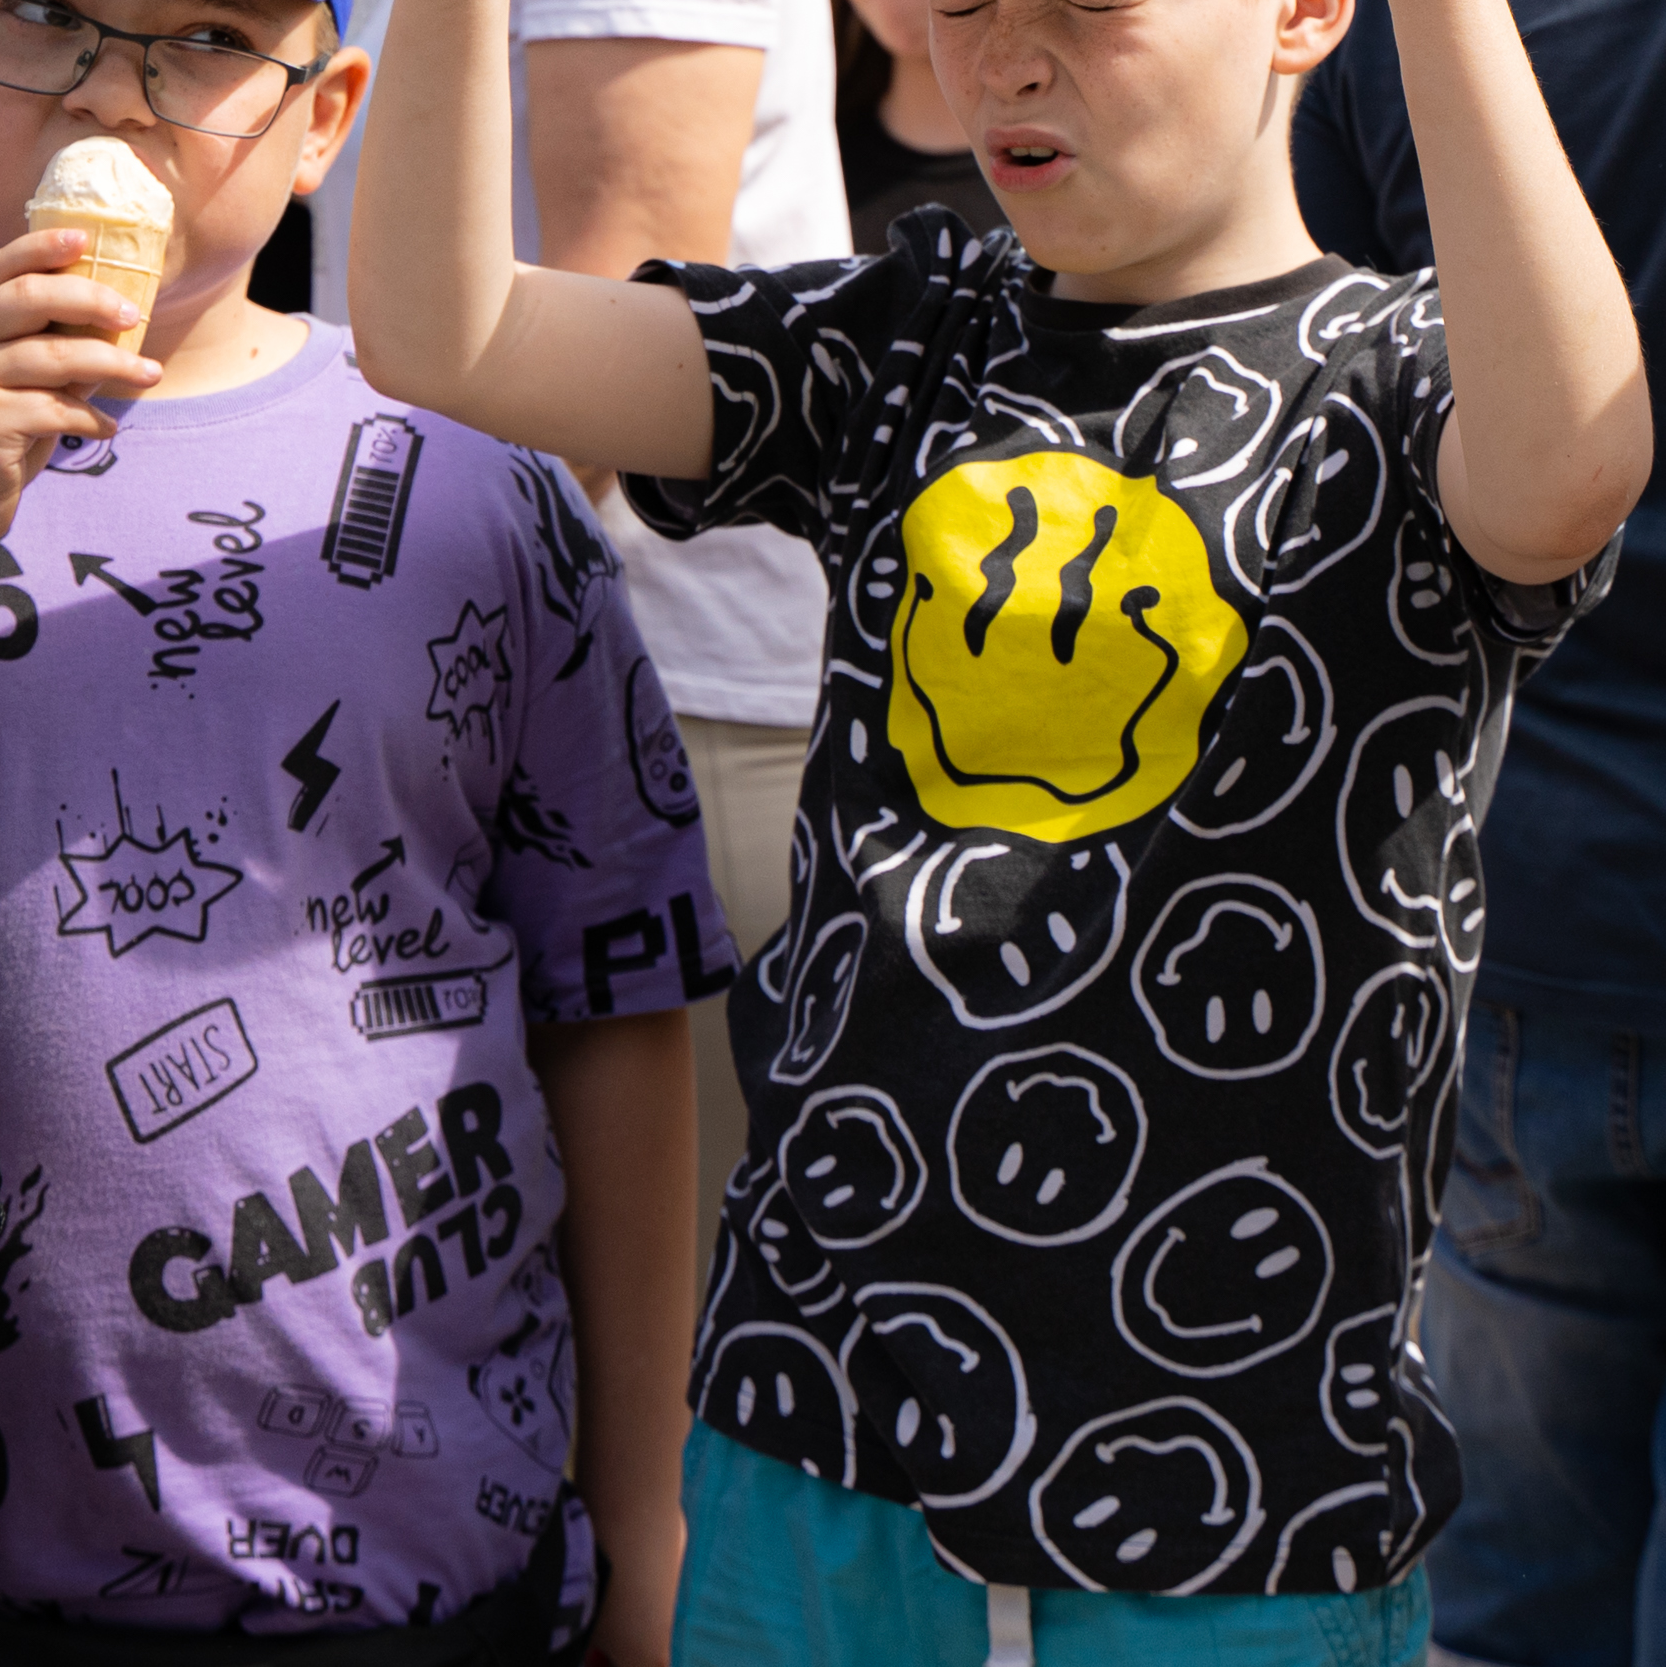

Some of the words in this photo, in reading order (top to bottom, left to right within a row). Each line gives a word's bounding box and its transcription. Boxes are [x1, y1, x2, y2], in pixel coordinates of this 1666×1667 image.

[147, 567, 201, 681] new
[302, 886, 390, 941] new
[331, 909, 452, 972] level
[136, 1022, 235, 1116] START
[128, 1081, 515, 1334] GAMER
[349, 1182, 523, 1338] CLUB
[228, 1518, 360, 1566] OVER
